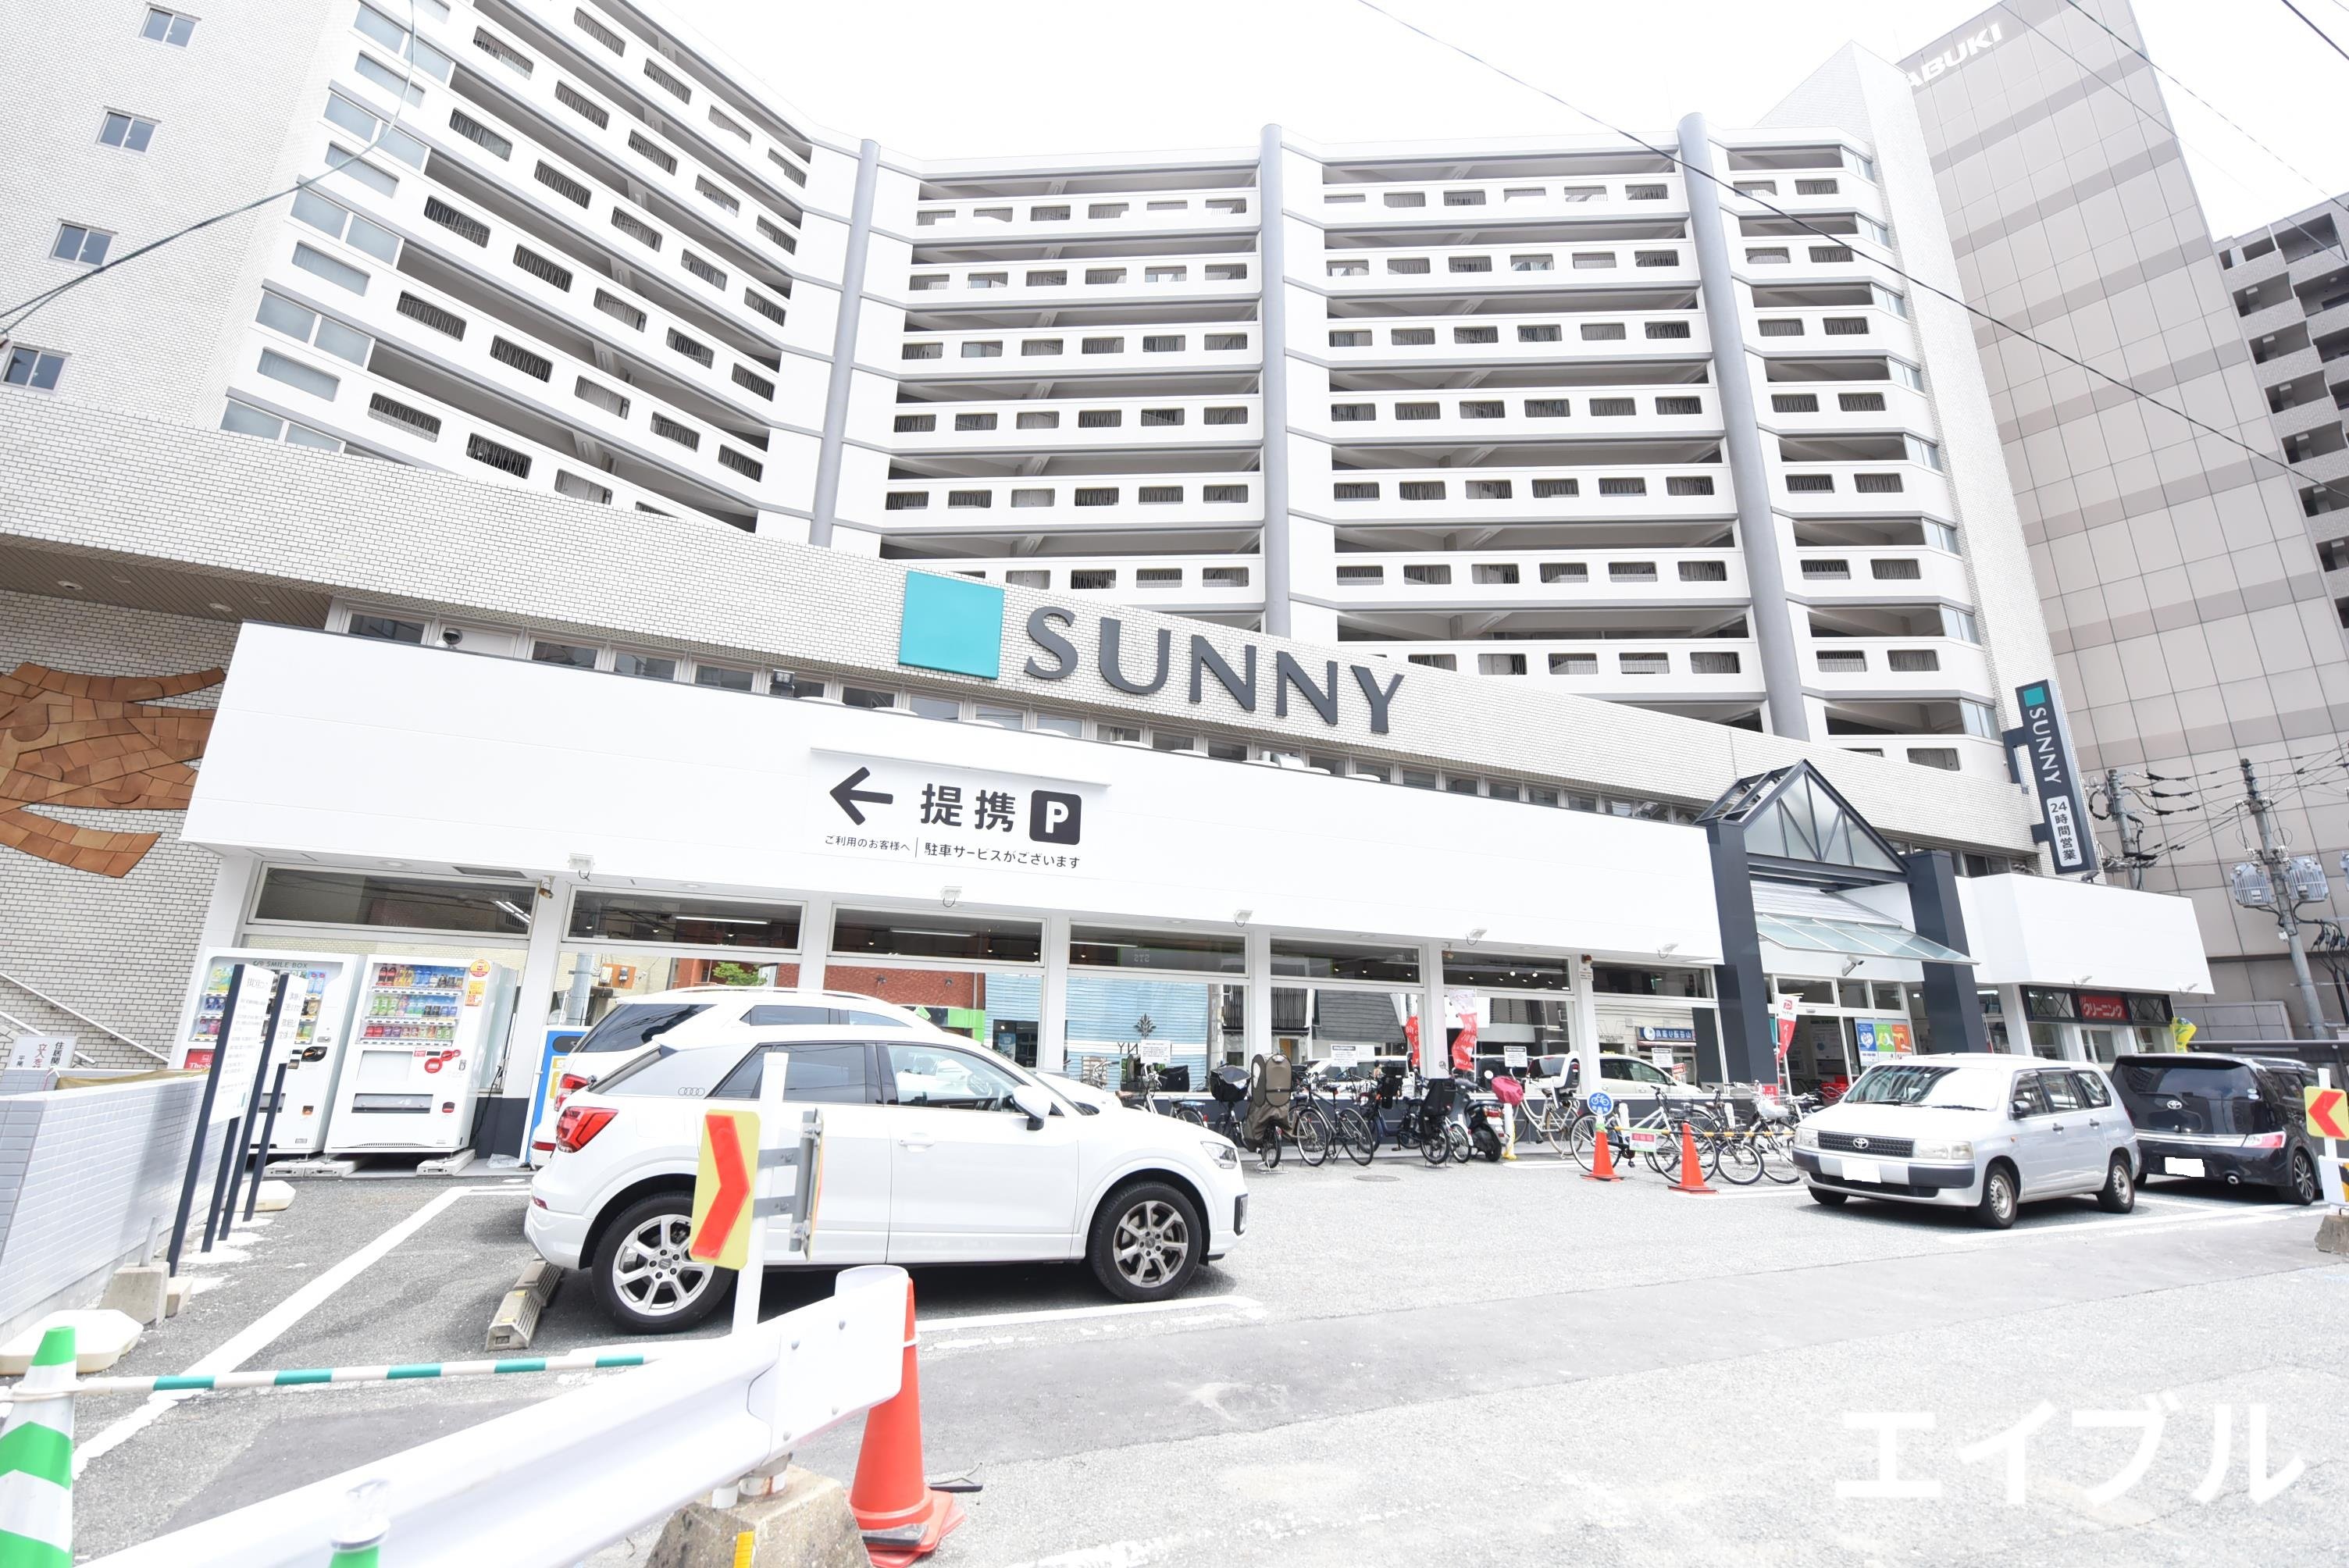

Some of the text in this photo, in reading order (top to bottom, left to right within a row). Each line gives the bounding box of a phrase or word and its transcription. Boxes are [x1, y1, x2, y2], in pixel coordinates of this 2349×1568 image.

[1024, 606, 1405, 734] SUNNY
[2029, 707, 2062, 784] SUNNY
[920, 782, 1069, 834] 提携 P
[825, 835, 1082, 869] ご利用のお客様へ 駐車サービスがございます
[2083, 1003, 2123, 1018] クリーニング
